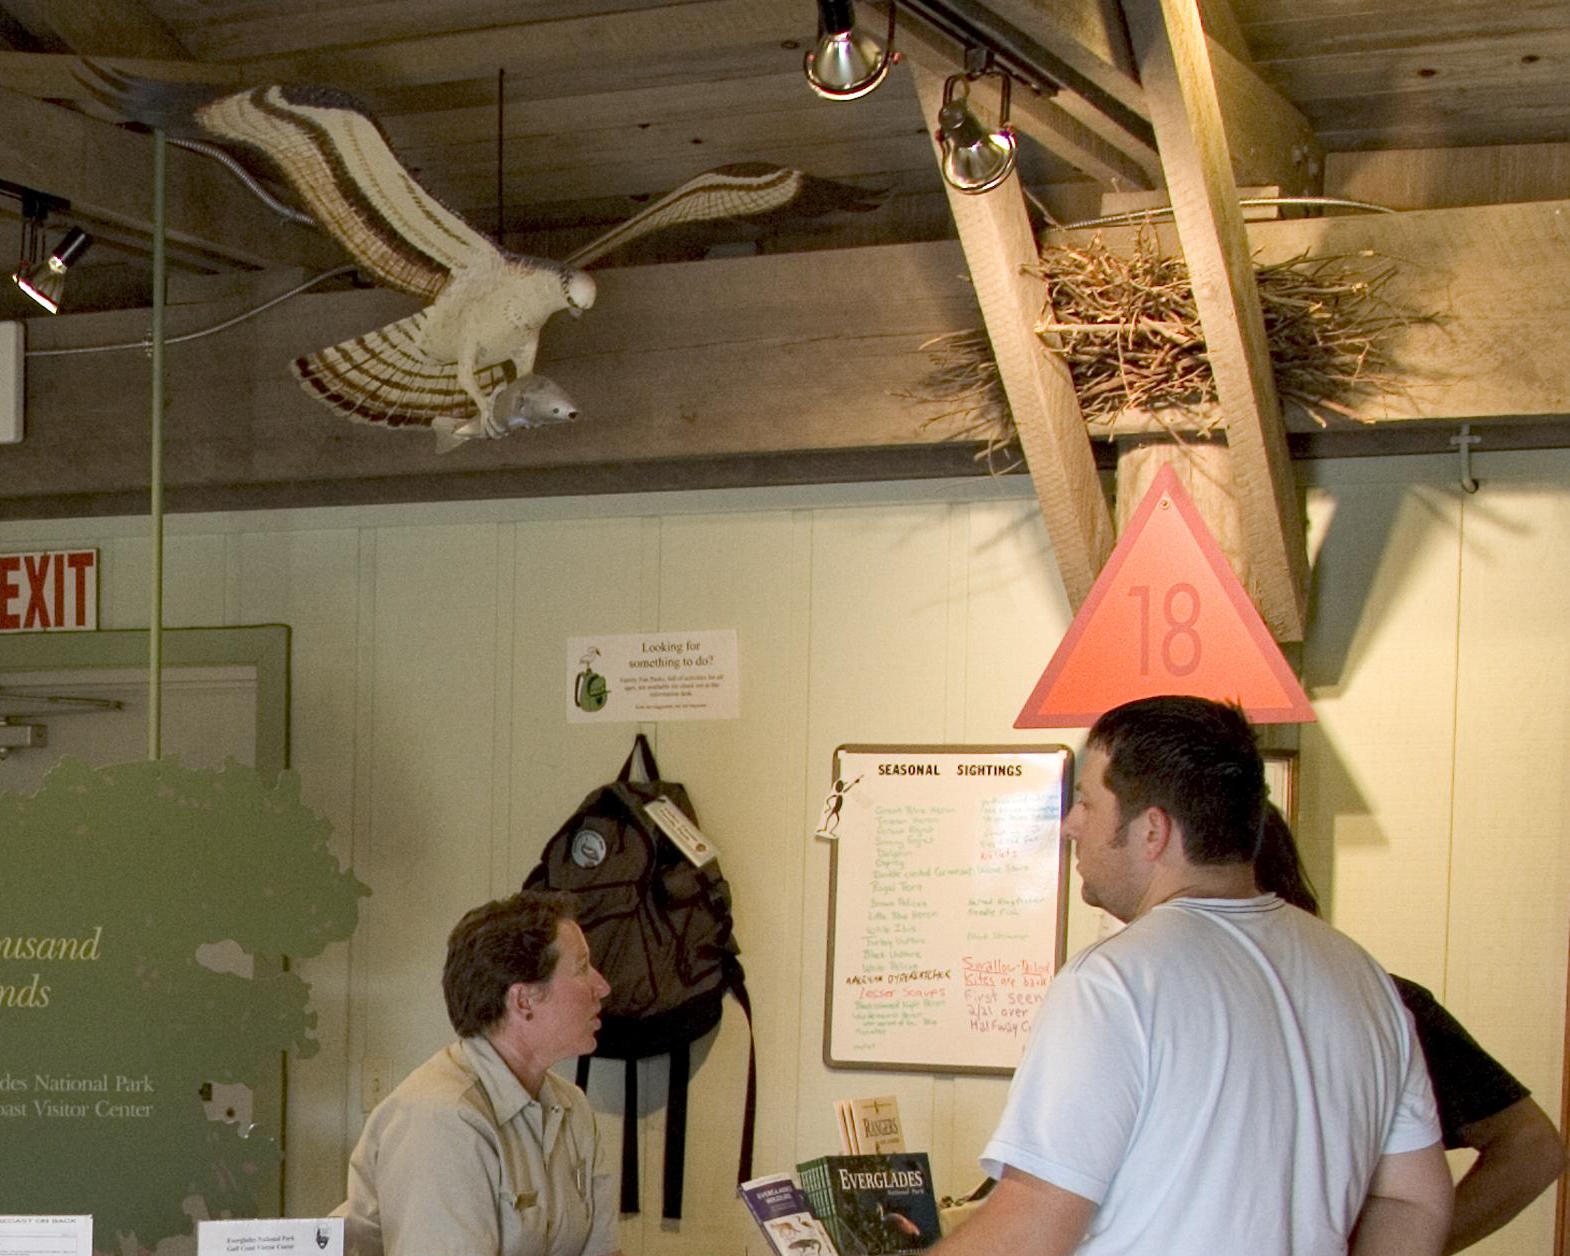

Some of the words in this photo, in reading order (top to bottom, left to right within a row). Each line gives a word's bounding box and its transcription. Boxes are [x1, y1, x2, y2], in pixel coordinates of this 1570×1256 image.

[1127, 582, 1202, 677] 18
[642, 642, 683, 654] Looking
[686, 640, 701, 651] for
[629, 657, 681, 669] something
[683, 658, 693, 666] to
[695, 655, 714, 666] do?
[878, 764, 941, 776] SEASONAL
[957, 765, 1023, 776] SIGHTINGS
[1000, 976, 1015, 987] are
[964, 989, 998, 1002] First
[1007, 991, 1045, 1005] seen
[1001, 1007, 1030, 1018] over
[35, 1074, 108, 1093] National
[115, 1074, 155, 1093] Park
[35, 1100, 89, 1117] Visitor
[95, 1100, 154, 1118] Center
[864, 1117, 898, 1138] RANGERS
[839, 1169, 923, 1190] EVERGLADES
[756, 1185, 793, 1200] EVERGLADES
